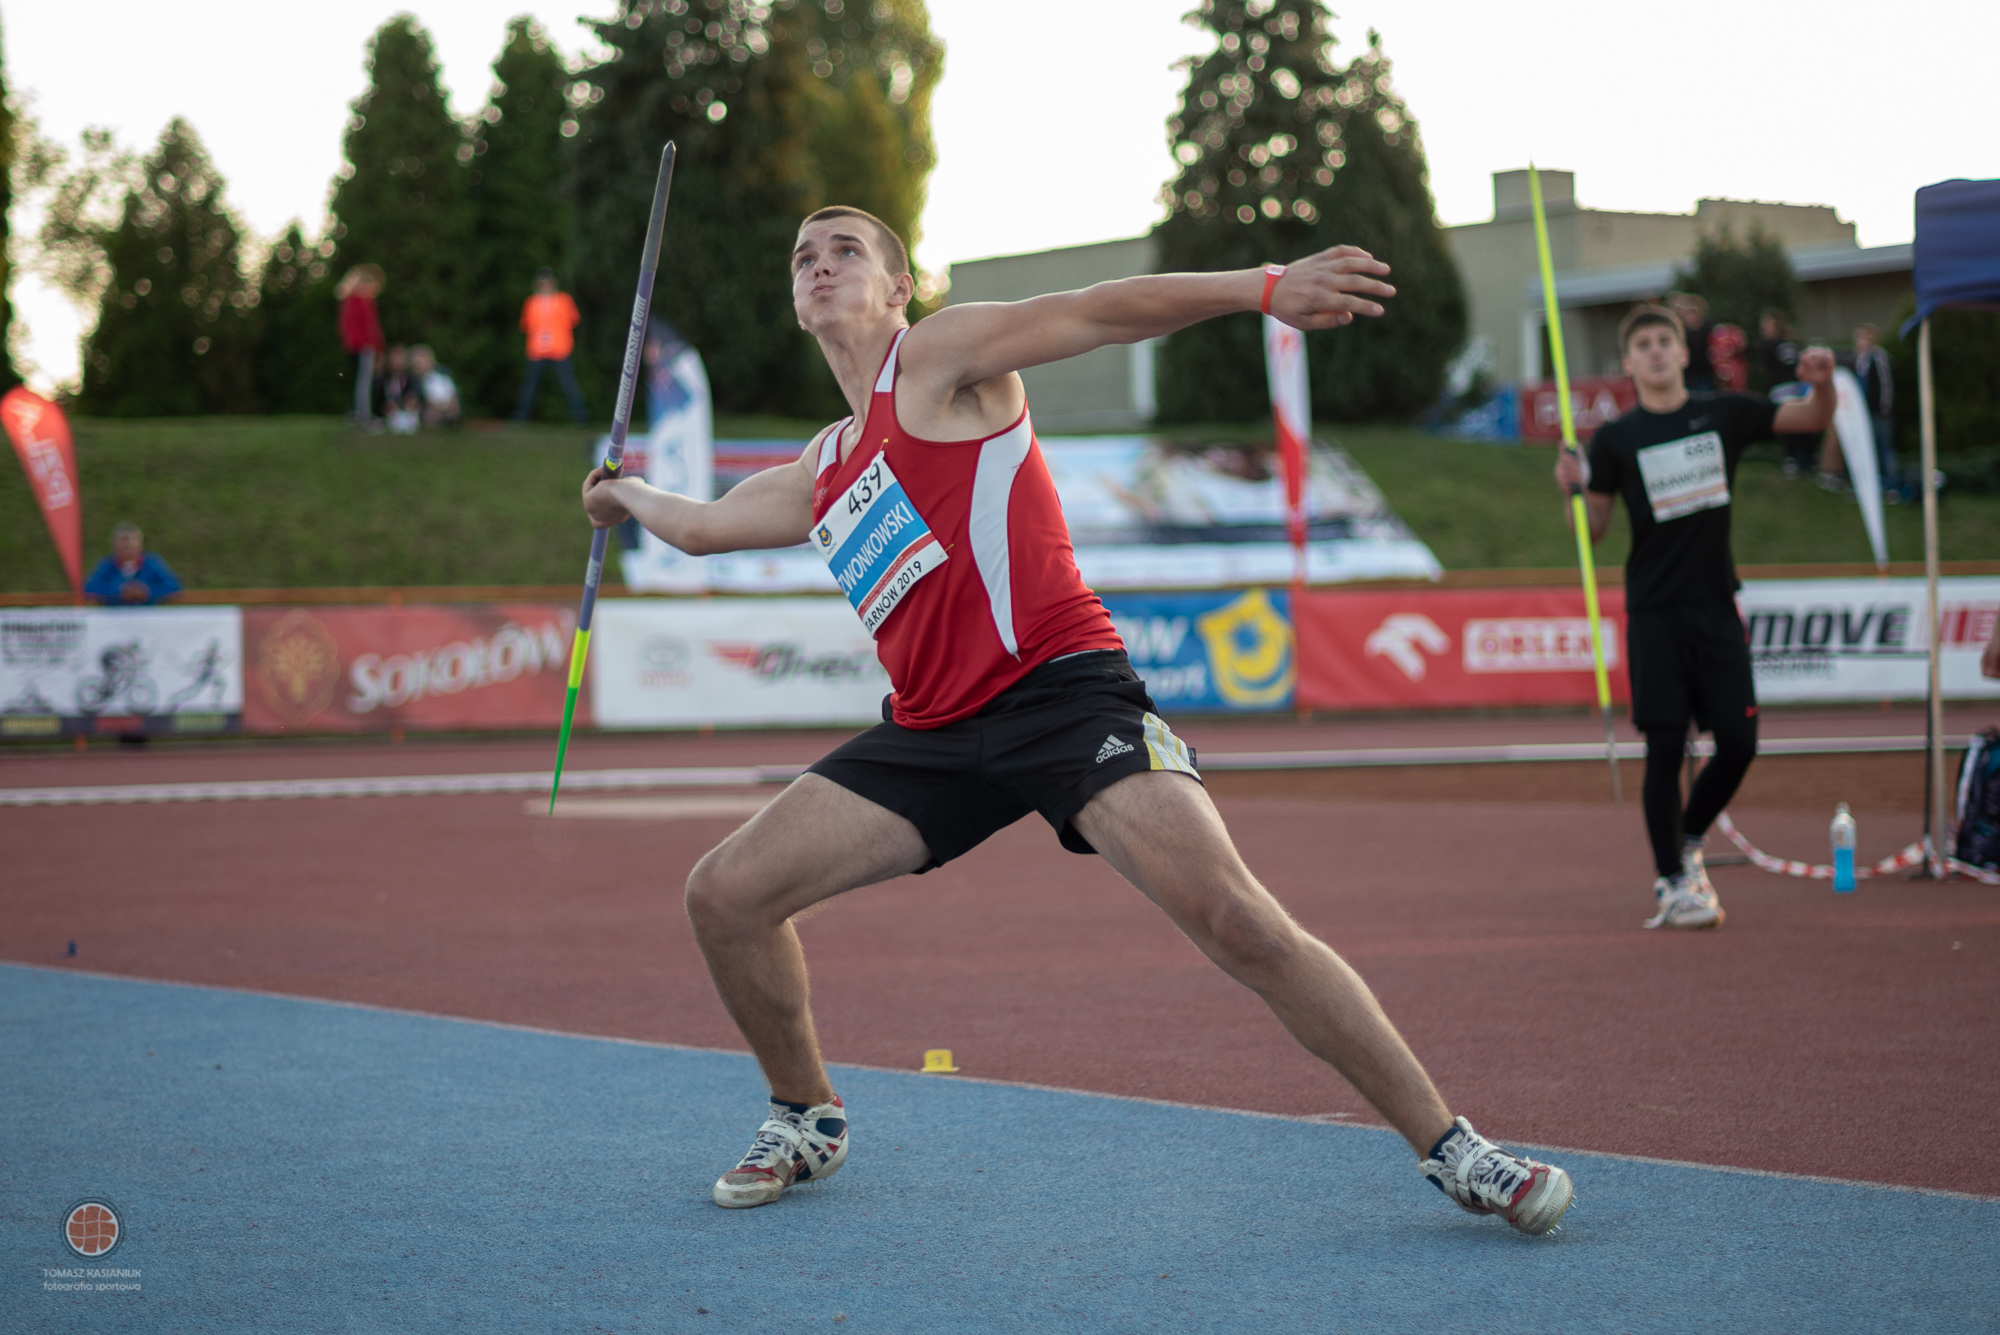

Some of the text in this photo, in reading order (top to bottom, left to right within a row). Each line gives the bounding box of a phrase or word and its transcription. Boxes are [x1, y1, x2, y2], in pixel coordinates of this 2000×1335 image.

[848, 462, 882, 516] 439
[865, 584, 899, 632] TARNÓW
[896, 560, 923, 591] 2019
[1095, 743, 1135, 764] adidas
